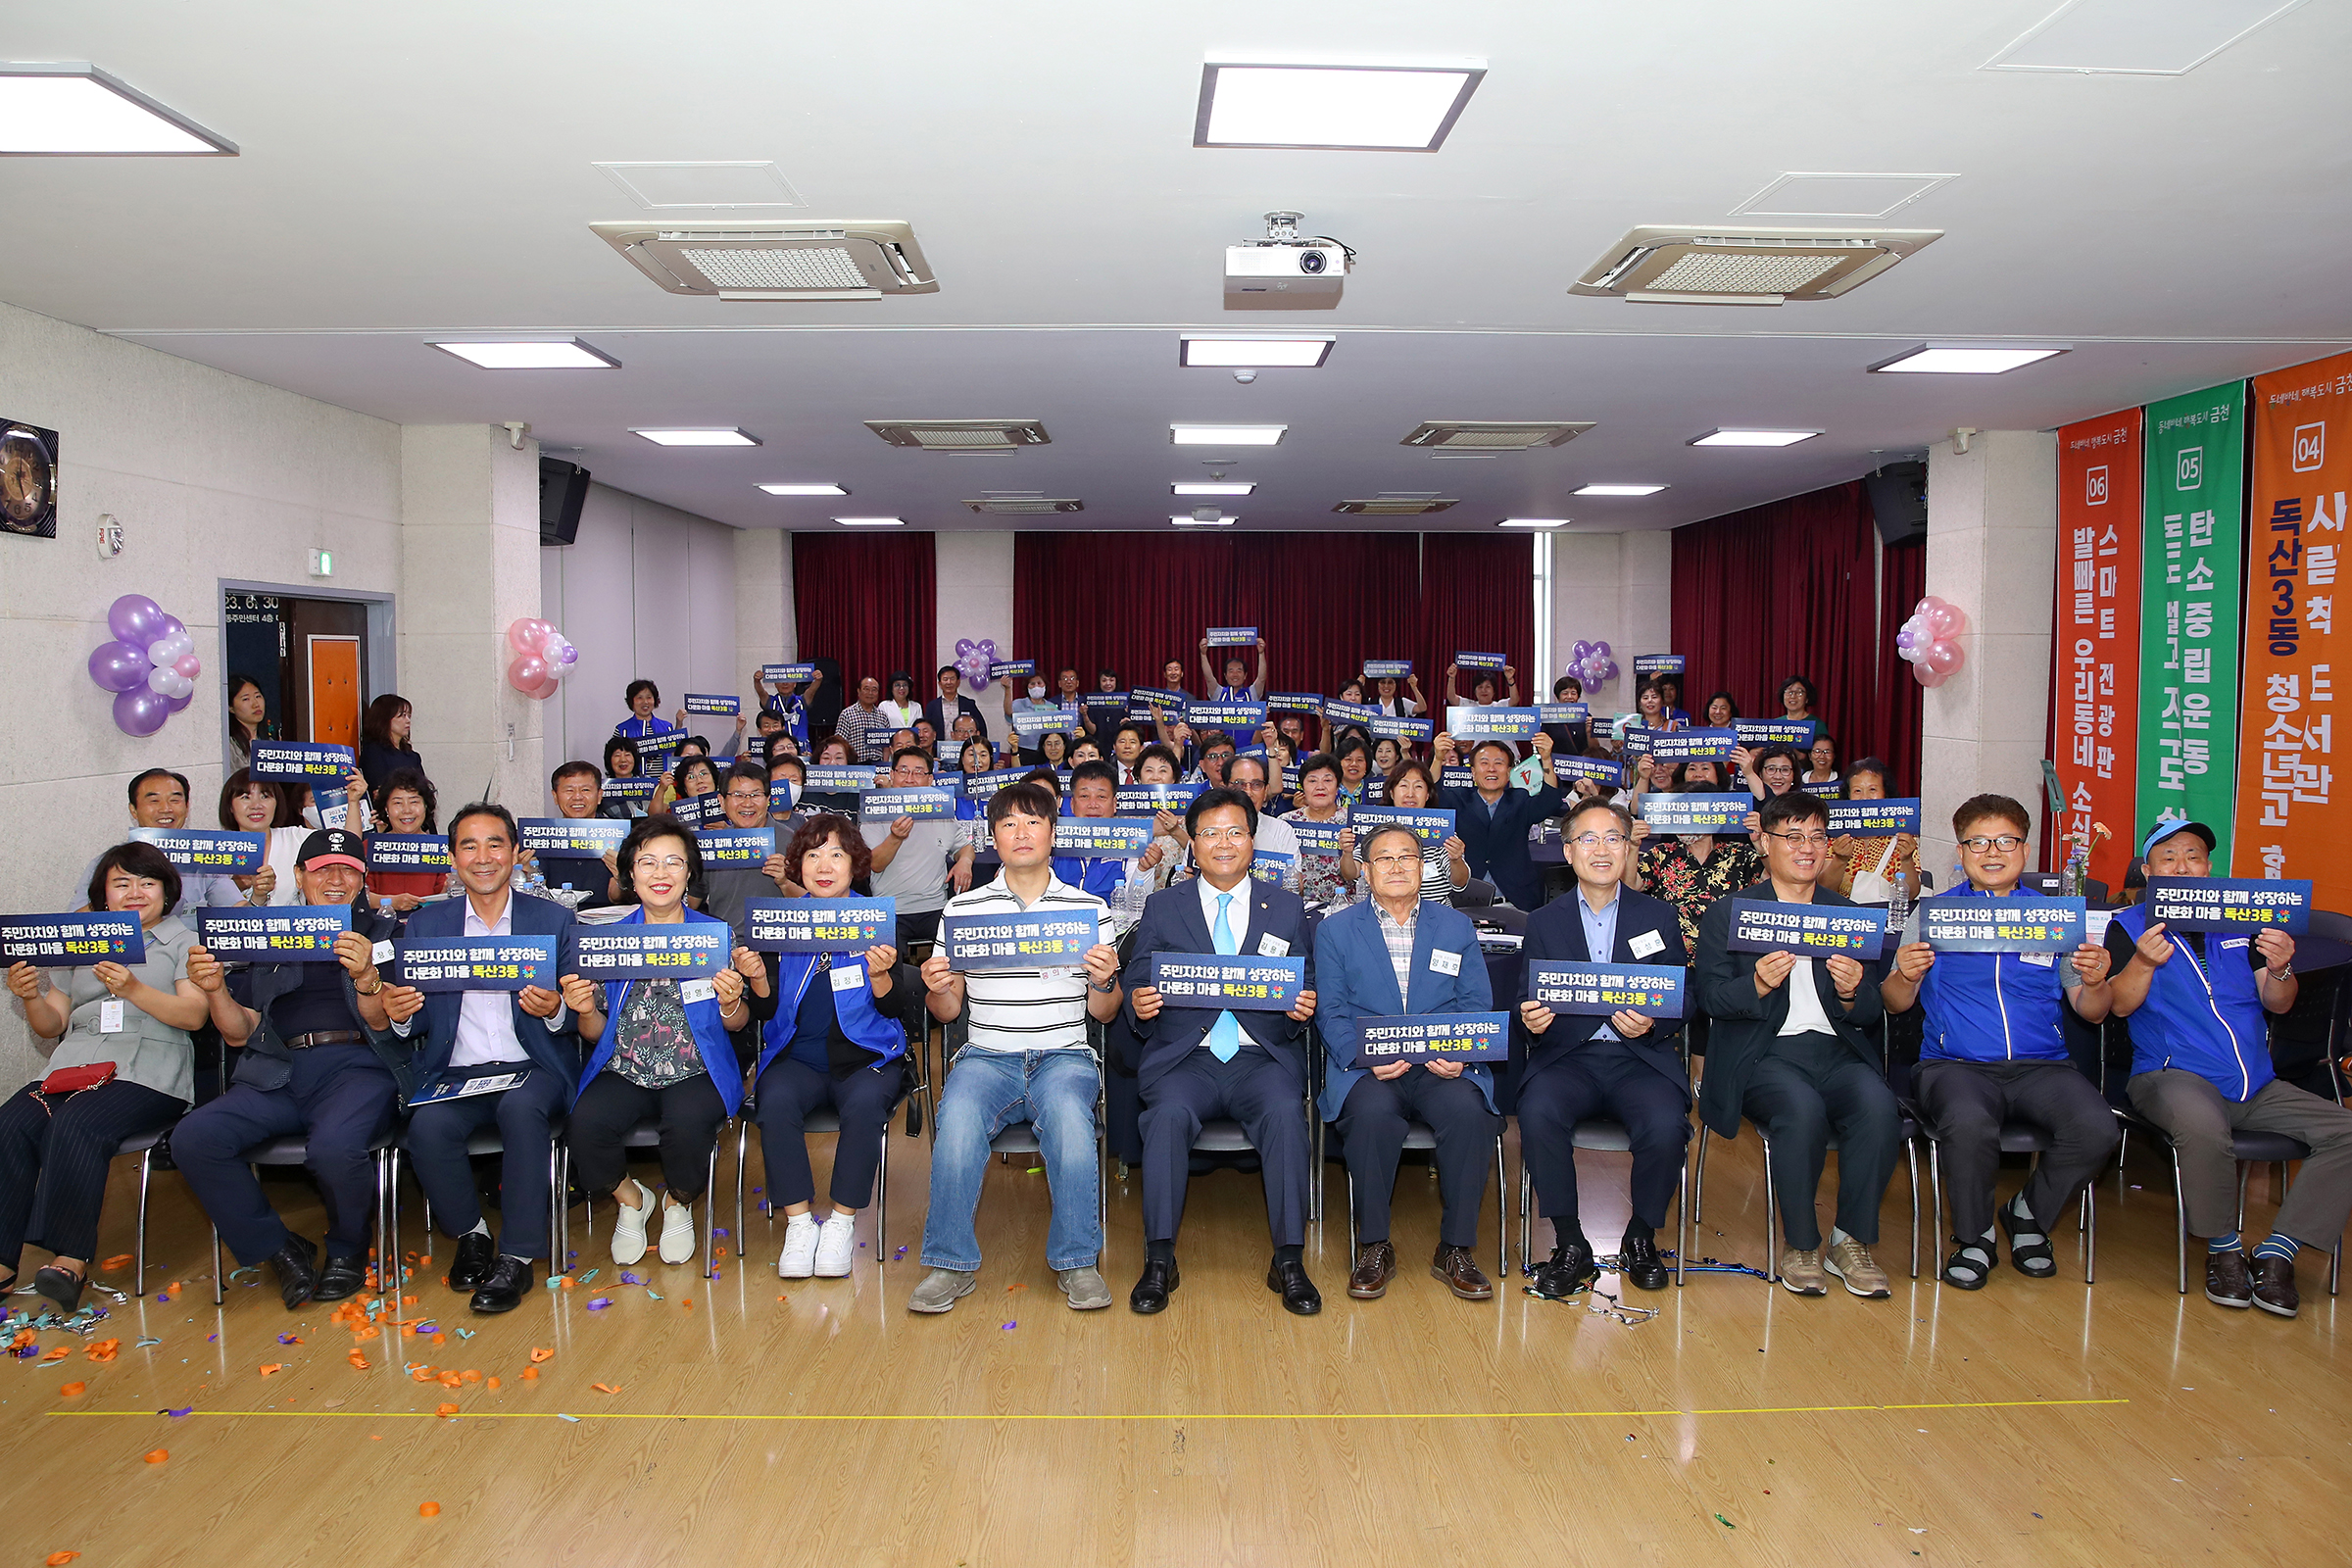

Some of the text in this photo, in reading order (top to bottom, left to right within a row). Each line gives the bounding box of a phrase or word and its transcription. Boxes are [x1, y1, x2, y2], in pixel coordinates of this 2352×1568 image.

[2210, 404, 2230, 423] 금천
[2113, 426, 2128, 444] 금천
[2298, 435, 2320, 463] 04
[2180, 457, 2199, 480] 05
[2089, 476, 2105, 497] 06
[2074, 526, 2095, 624] 발빠른
[2268, 498, 2302, 657] 독산3동
[2096, 524, 2118, 779] 스마트 전광판
[1189, 706, 1221, 714] 주민자치와
[2073, 638, 2095, 767] 우리동네
[1652, 736, 1732, 747] 주민자치와 함께 성장하는
[257, 749, 352, 763] 주민자치와 함께 성장하는
[1652, 746, 1716, 757] 다문화 마을 독산3동
[256, 761, 337, 774] 다문화 마을 독산3동
[864, 793, 949, 805] 주민자치와 함께 성장하는
[1643, 802, 1746, 811] 주민자치와 함께 성장하는
[864, 804, 933, 814] 다문화 마을 독산3동
[1642, 813, 1727, 824] 다문화 마을 독산3동
[522, 826, 624, 837] 주민자치와 함께 성장하는
[522, 838, 604, 850] 다문화 마을 독산3동
[2155, 888, 2302, 906] 주민자치와 함께 성장하는
[751, 908, 887, 923] 주민자치와 함께 성장하는
[1739, 910, 1877, 932] 주민자치와 함께 성장하는
[1928, 907, 2077, 922] 주민자치와 함께 성장하는
[2154, 905, 2273, 922] 다문화 마을 독산3동
[1, 922, 133, 940] 주민자치와 함께 성장하는
[205, 917, 343, 933] 주민자치와 함께 성장하는
[751, 925, 859, 940] 다문화 마을 독산3동
[953, 921, 1090, 941] 주민자치와 함께 성장하는
[1928, 925, 2046, 940] 다문화 마을 독산3동
[206, 935, 315, 951] 다문화 마을 독산3동
[578, 935, 718, 951] 주민자치와 함께 성장하는
[1737, 926, 1847, 948] 다문화 마을 독산3동
[3, 940, 109, 956] 다문화 마을 독산3동
[403, 948, 467, 963] 주민자치와
[468, 948, 495, 961] 함께
[496, 947, 547, 961] 성장하는
[953, 939, 1063, 957] 다문화 마을 독산3동
[578, 952, 691, 967] 다문화 마을 독산3동
[404, 964, 518, 980] 다문화 마을 독산3동
[1158, 963, 1296, 982] 주민자치와 함께 성장하는
[1537, 971, 1675, 990] 주민자치와 함께 성장하는
[1157, 980, 1267, 998] 다문화 마을 독산3동
[1536, 988, 1646, 1005] 다문화 마을 독산3동
[1364, 1022, 1499, 1040] 주민자치와 함께 성장하는
[1364, 1038, 1473, 1054] 다문화 마을 독산3동
